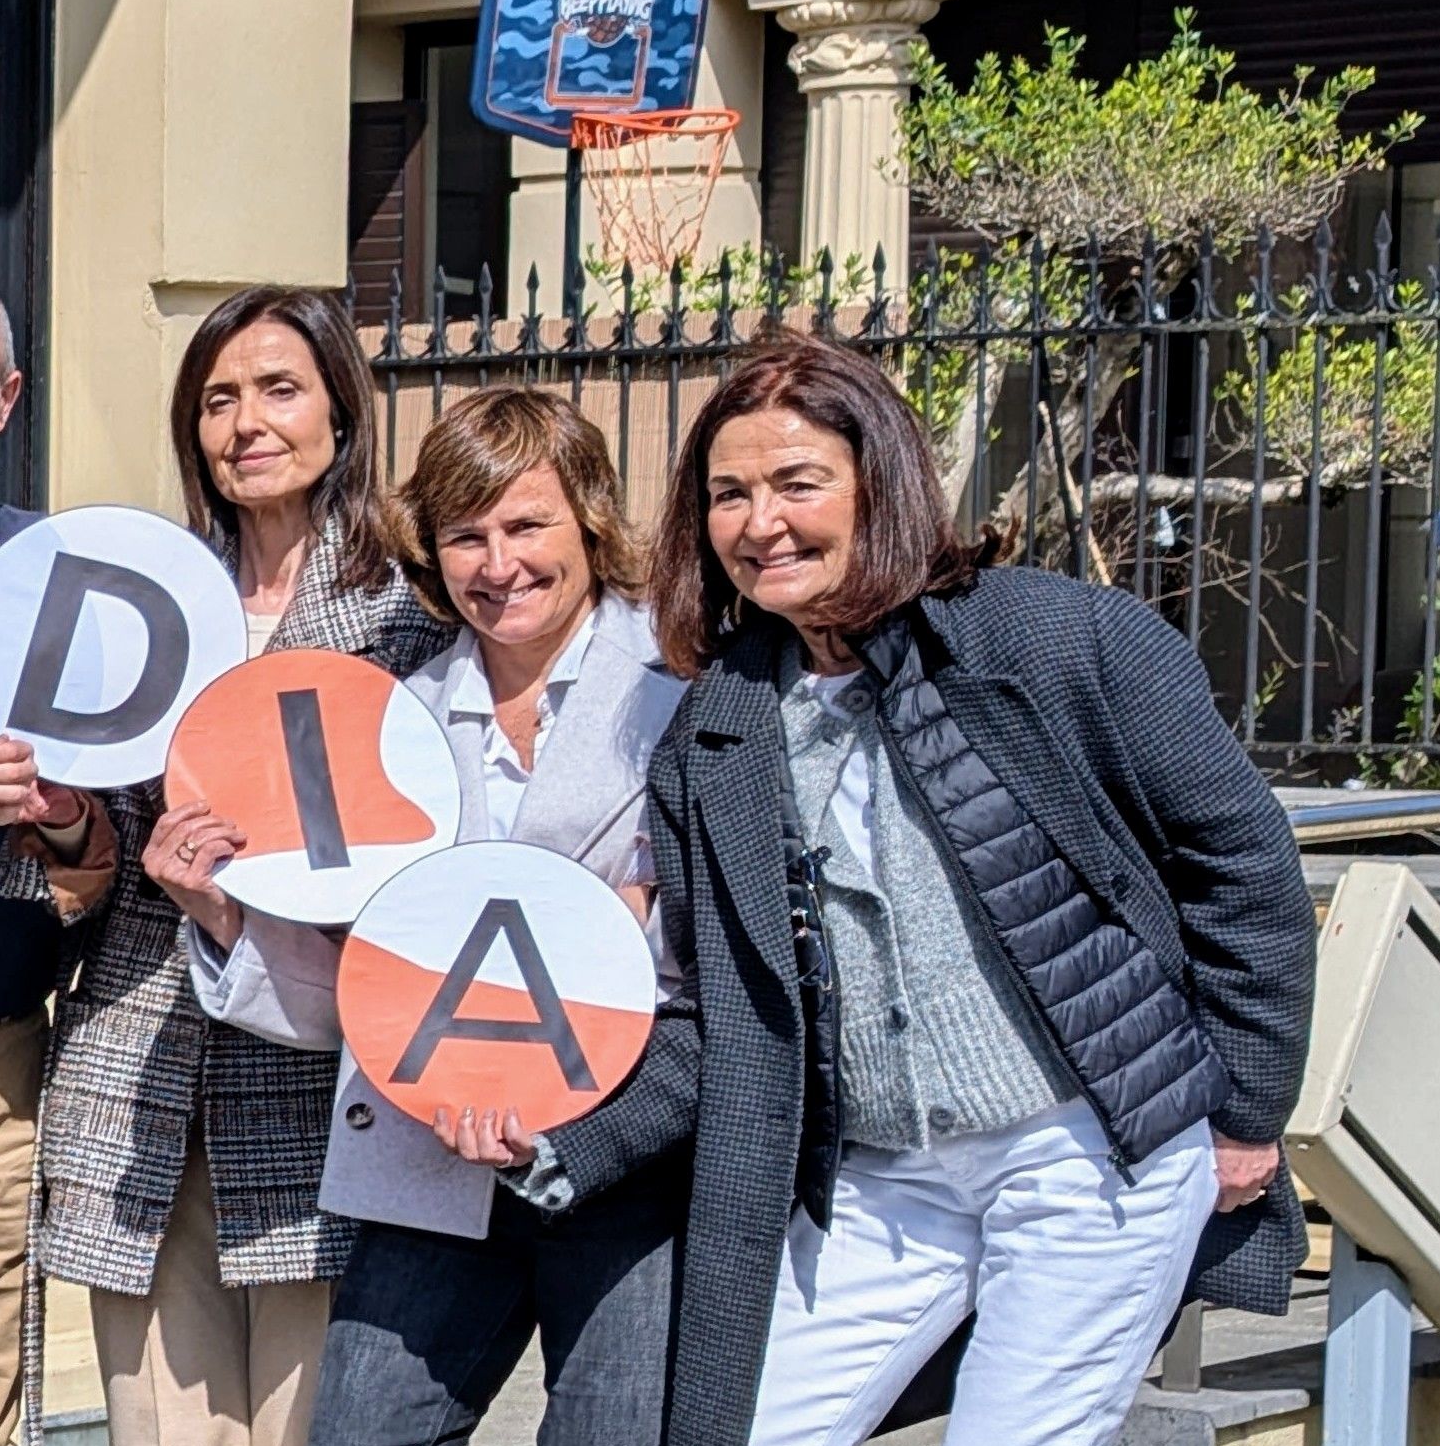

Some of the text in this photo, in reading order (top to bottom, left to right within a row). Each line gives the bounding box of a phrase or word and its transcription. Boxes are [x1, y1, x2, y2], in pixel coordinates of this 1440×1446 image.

[6, 550, 191, 745] D
[275, 687, 352, 871] I
[388, 897, 600, 1093] A
